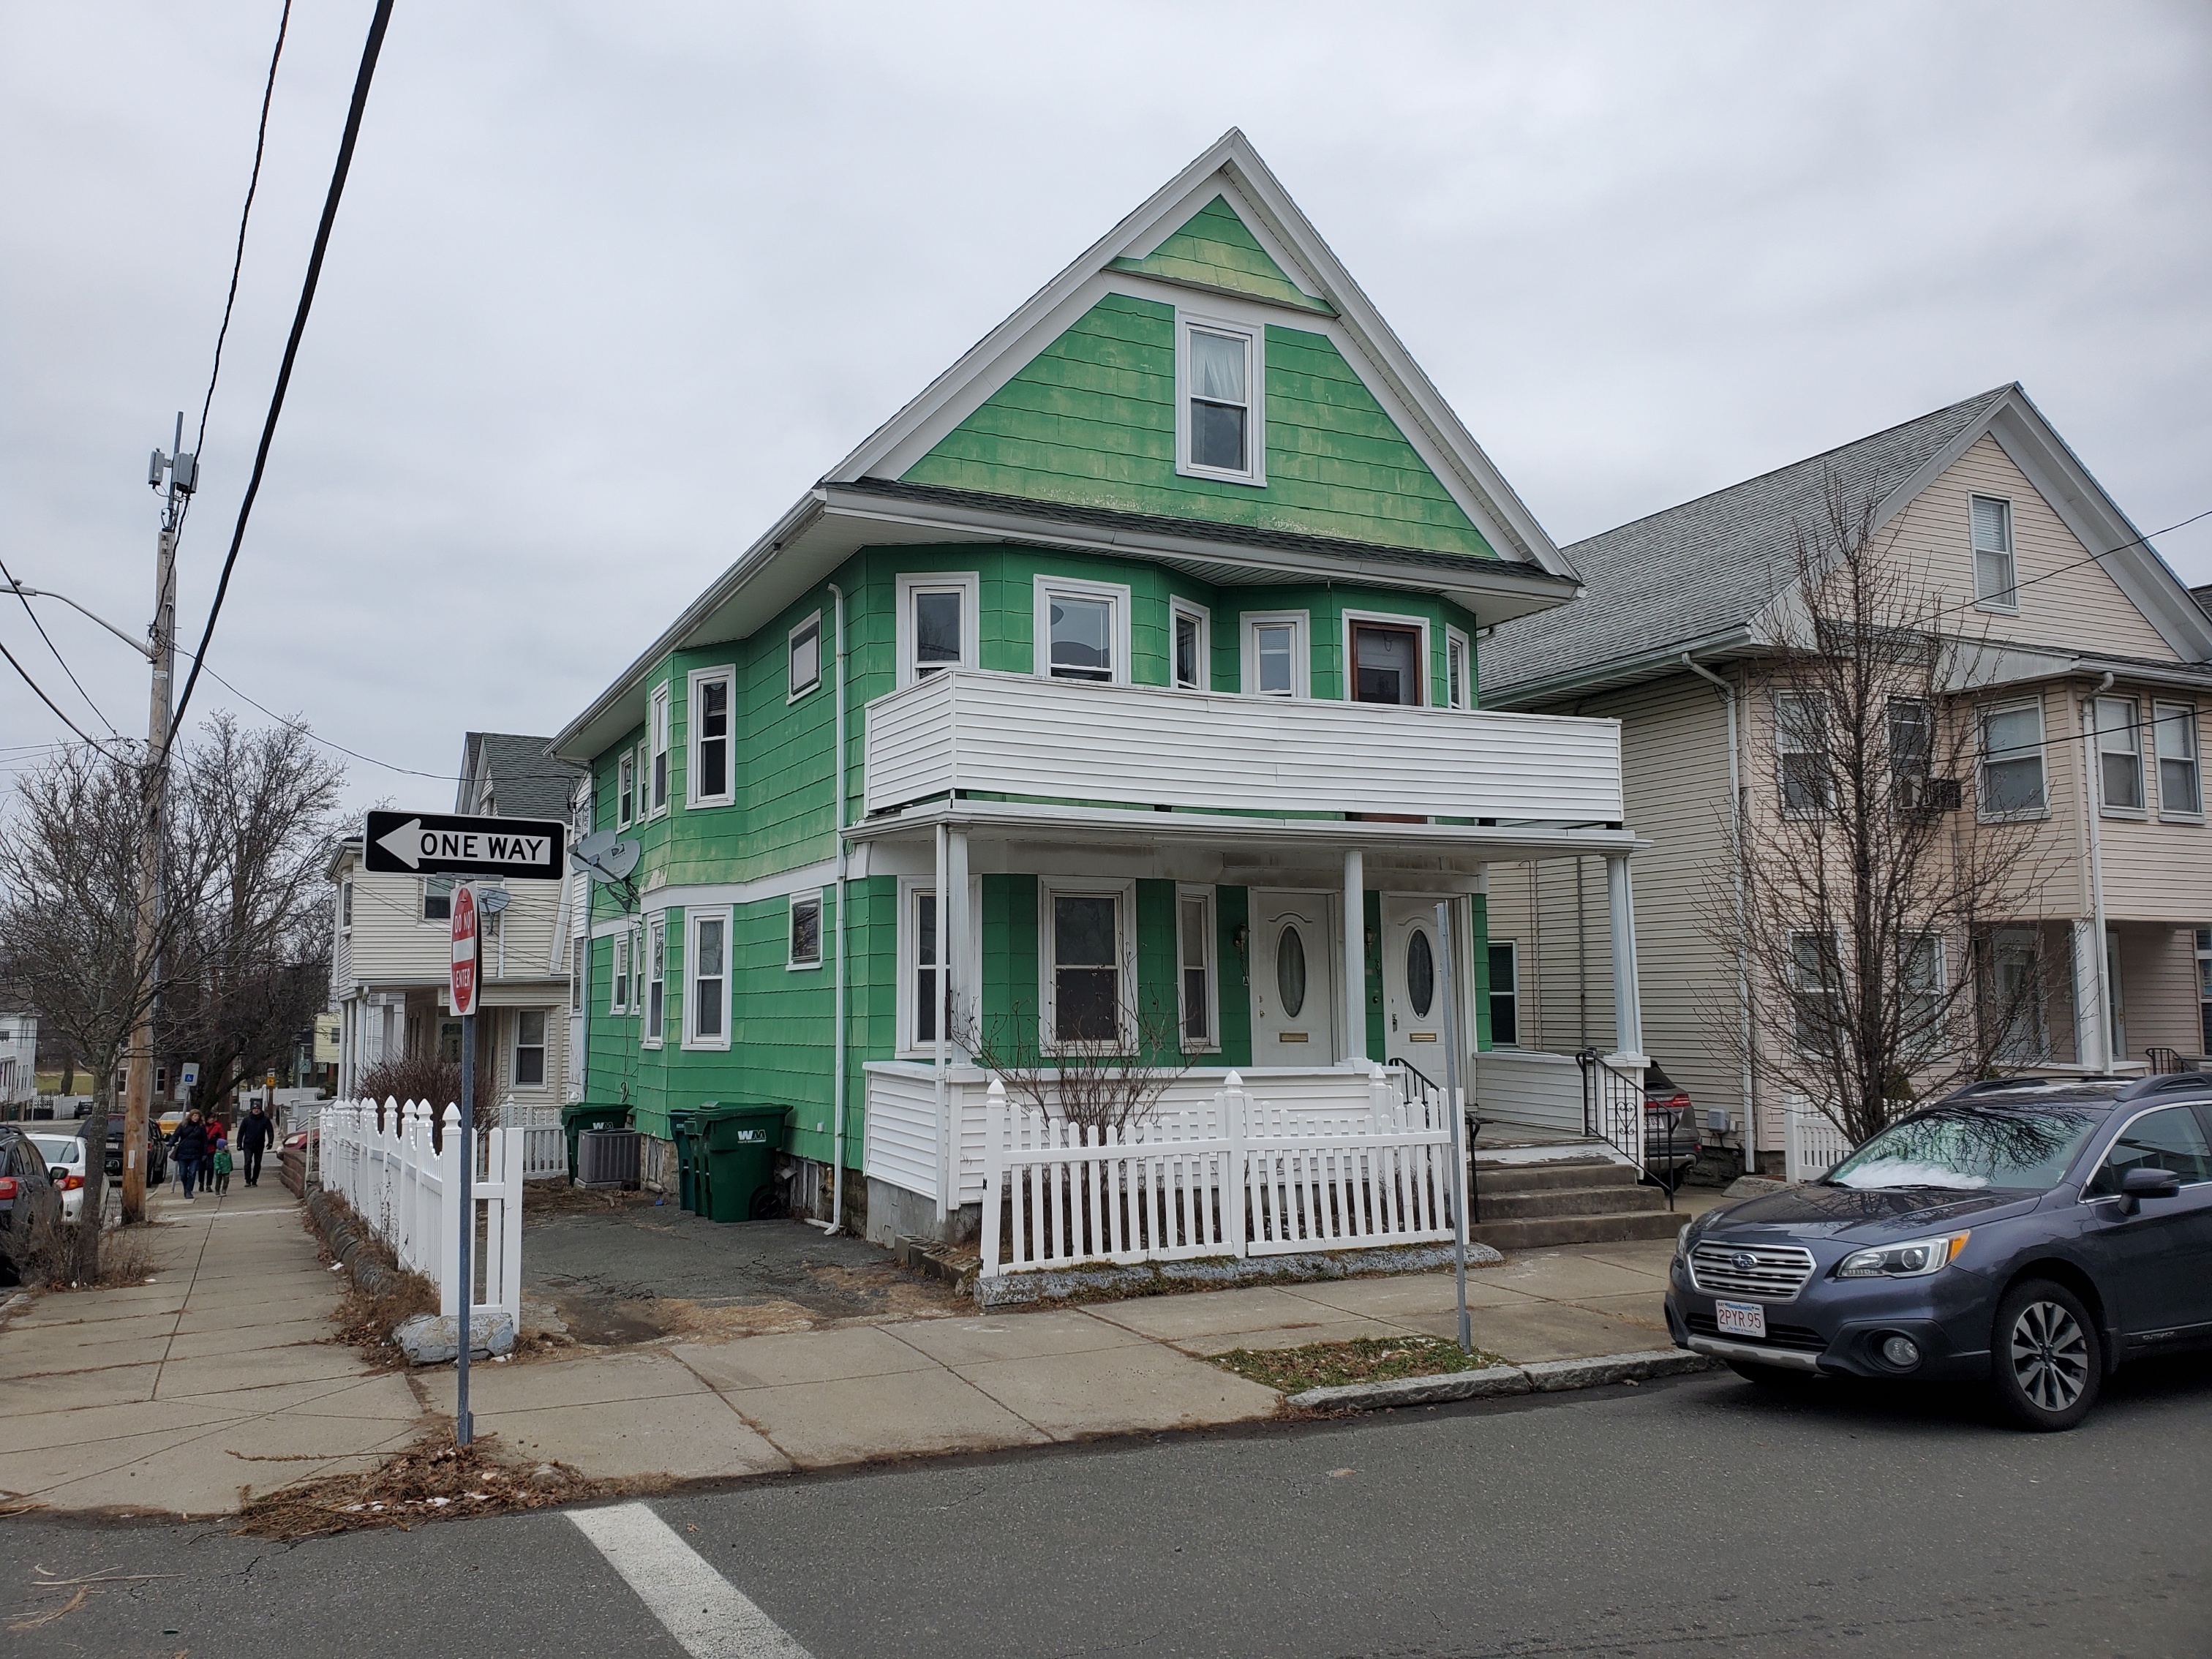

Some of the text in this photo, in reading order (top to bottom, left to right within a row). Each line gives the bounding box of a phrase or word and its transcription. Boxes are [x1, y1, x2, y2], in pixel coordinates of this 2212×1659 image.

[421, 832, 543, 861] ONE WAY
[454, 910, 473, 933] DO NOT
[456, 968, 470, 988] ENTER
[592, 1121, 614, 1129] WM
[737, 1129, 767, 1140] WM
[1719, 1309, 1761, 1329] 2PYR 95
